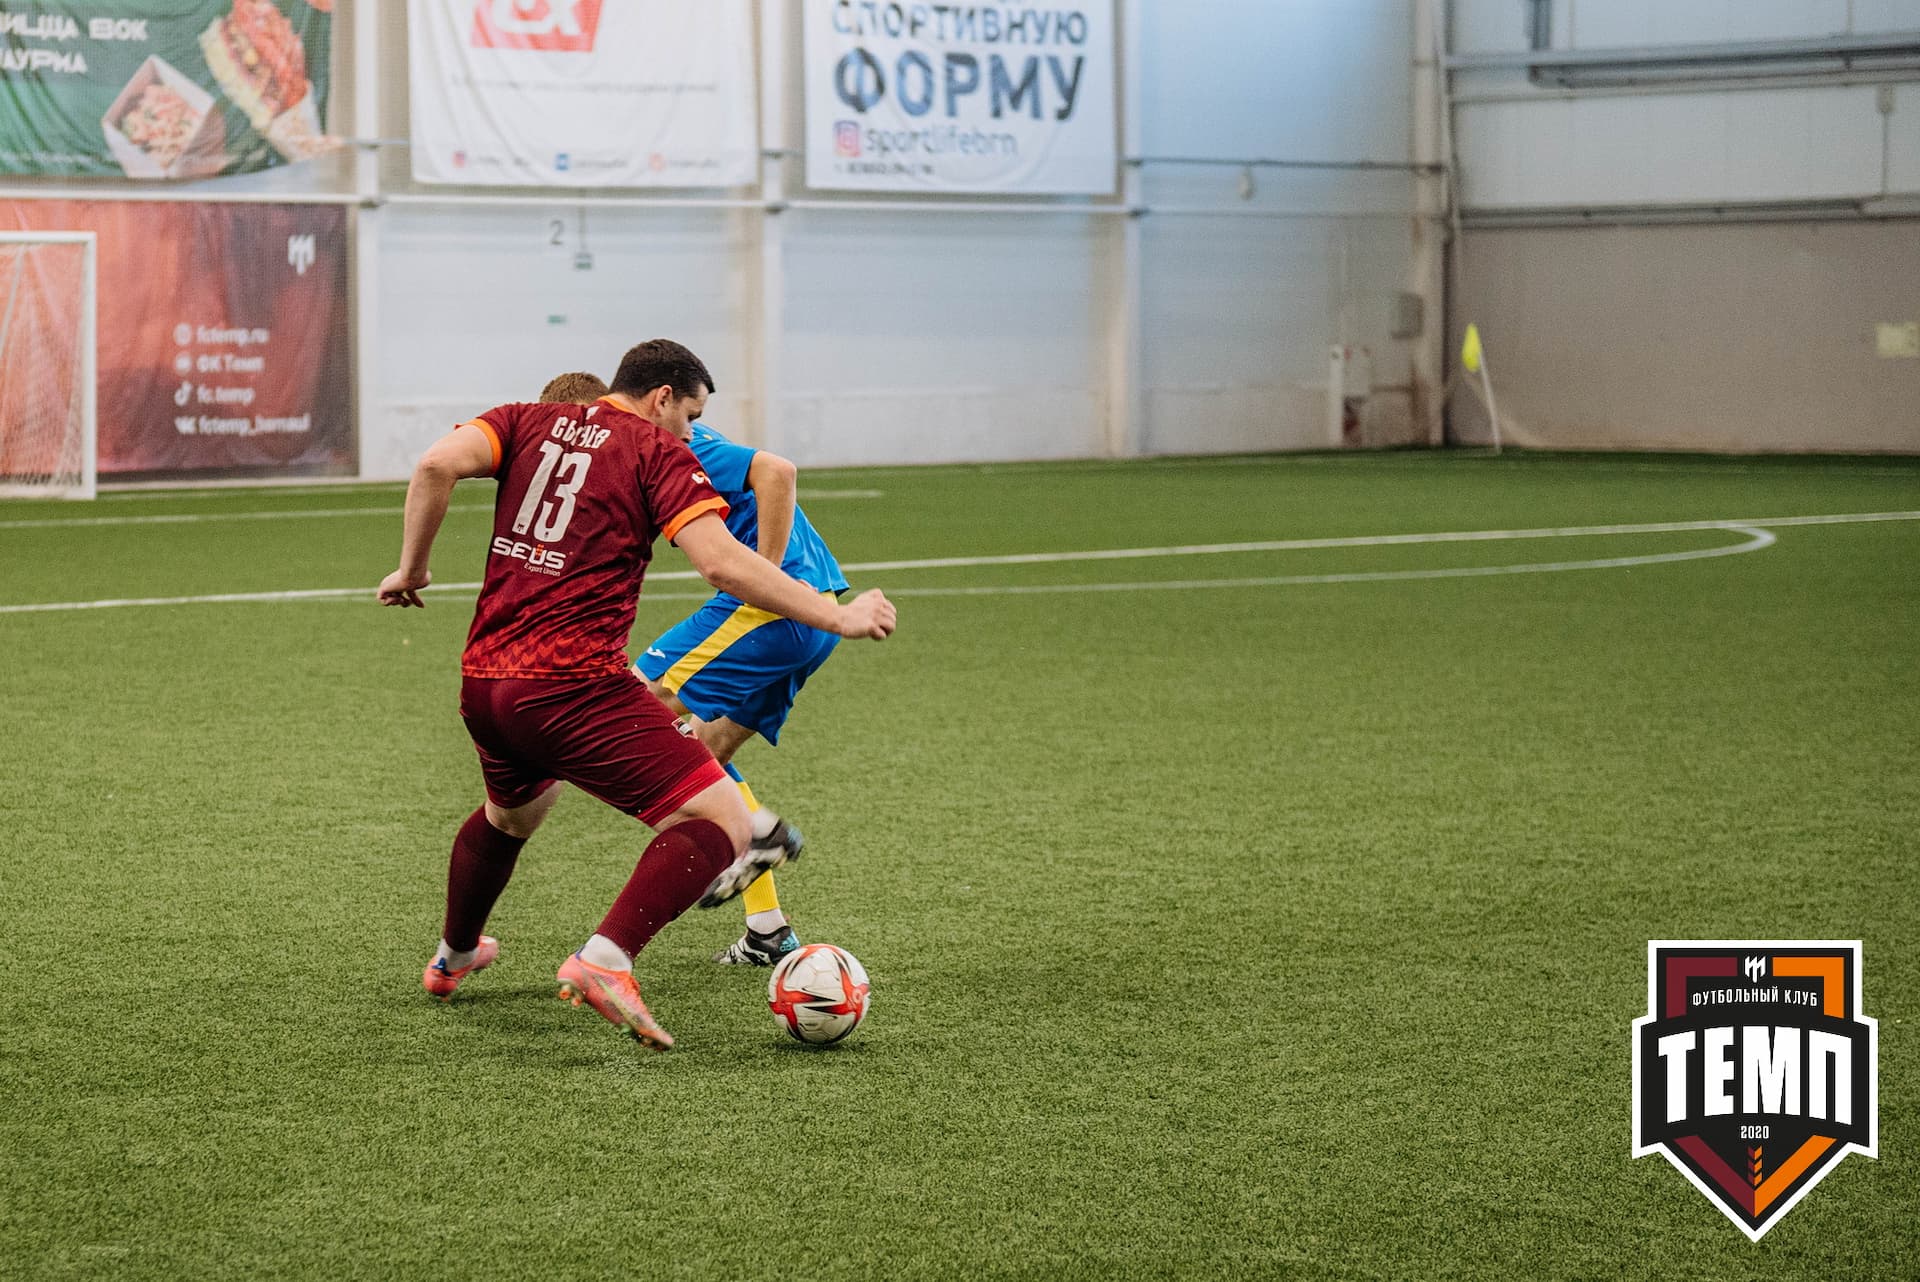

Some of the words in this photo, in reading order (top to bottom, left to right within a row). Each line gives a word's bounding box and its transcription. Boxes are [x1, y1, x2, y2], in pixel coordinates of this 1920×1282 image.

[89, 17, 148, 41] ВОК
[833, 0, 1088, 45] СПОРТИВНУЮ
[834, 47, 1085, 121] ФОРМУ
[512, 440, 592, 543] 13
